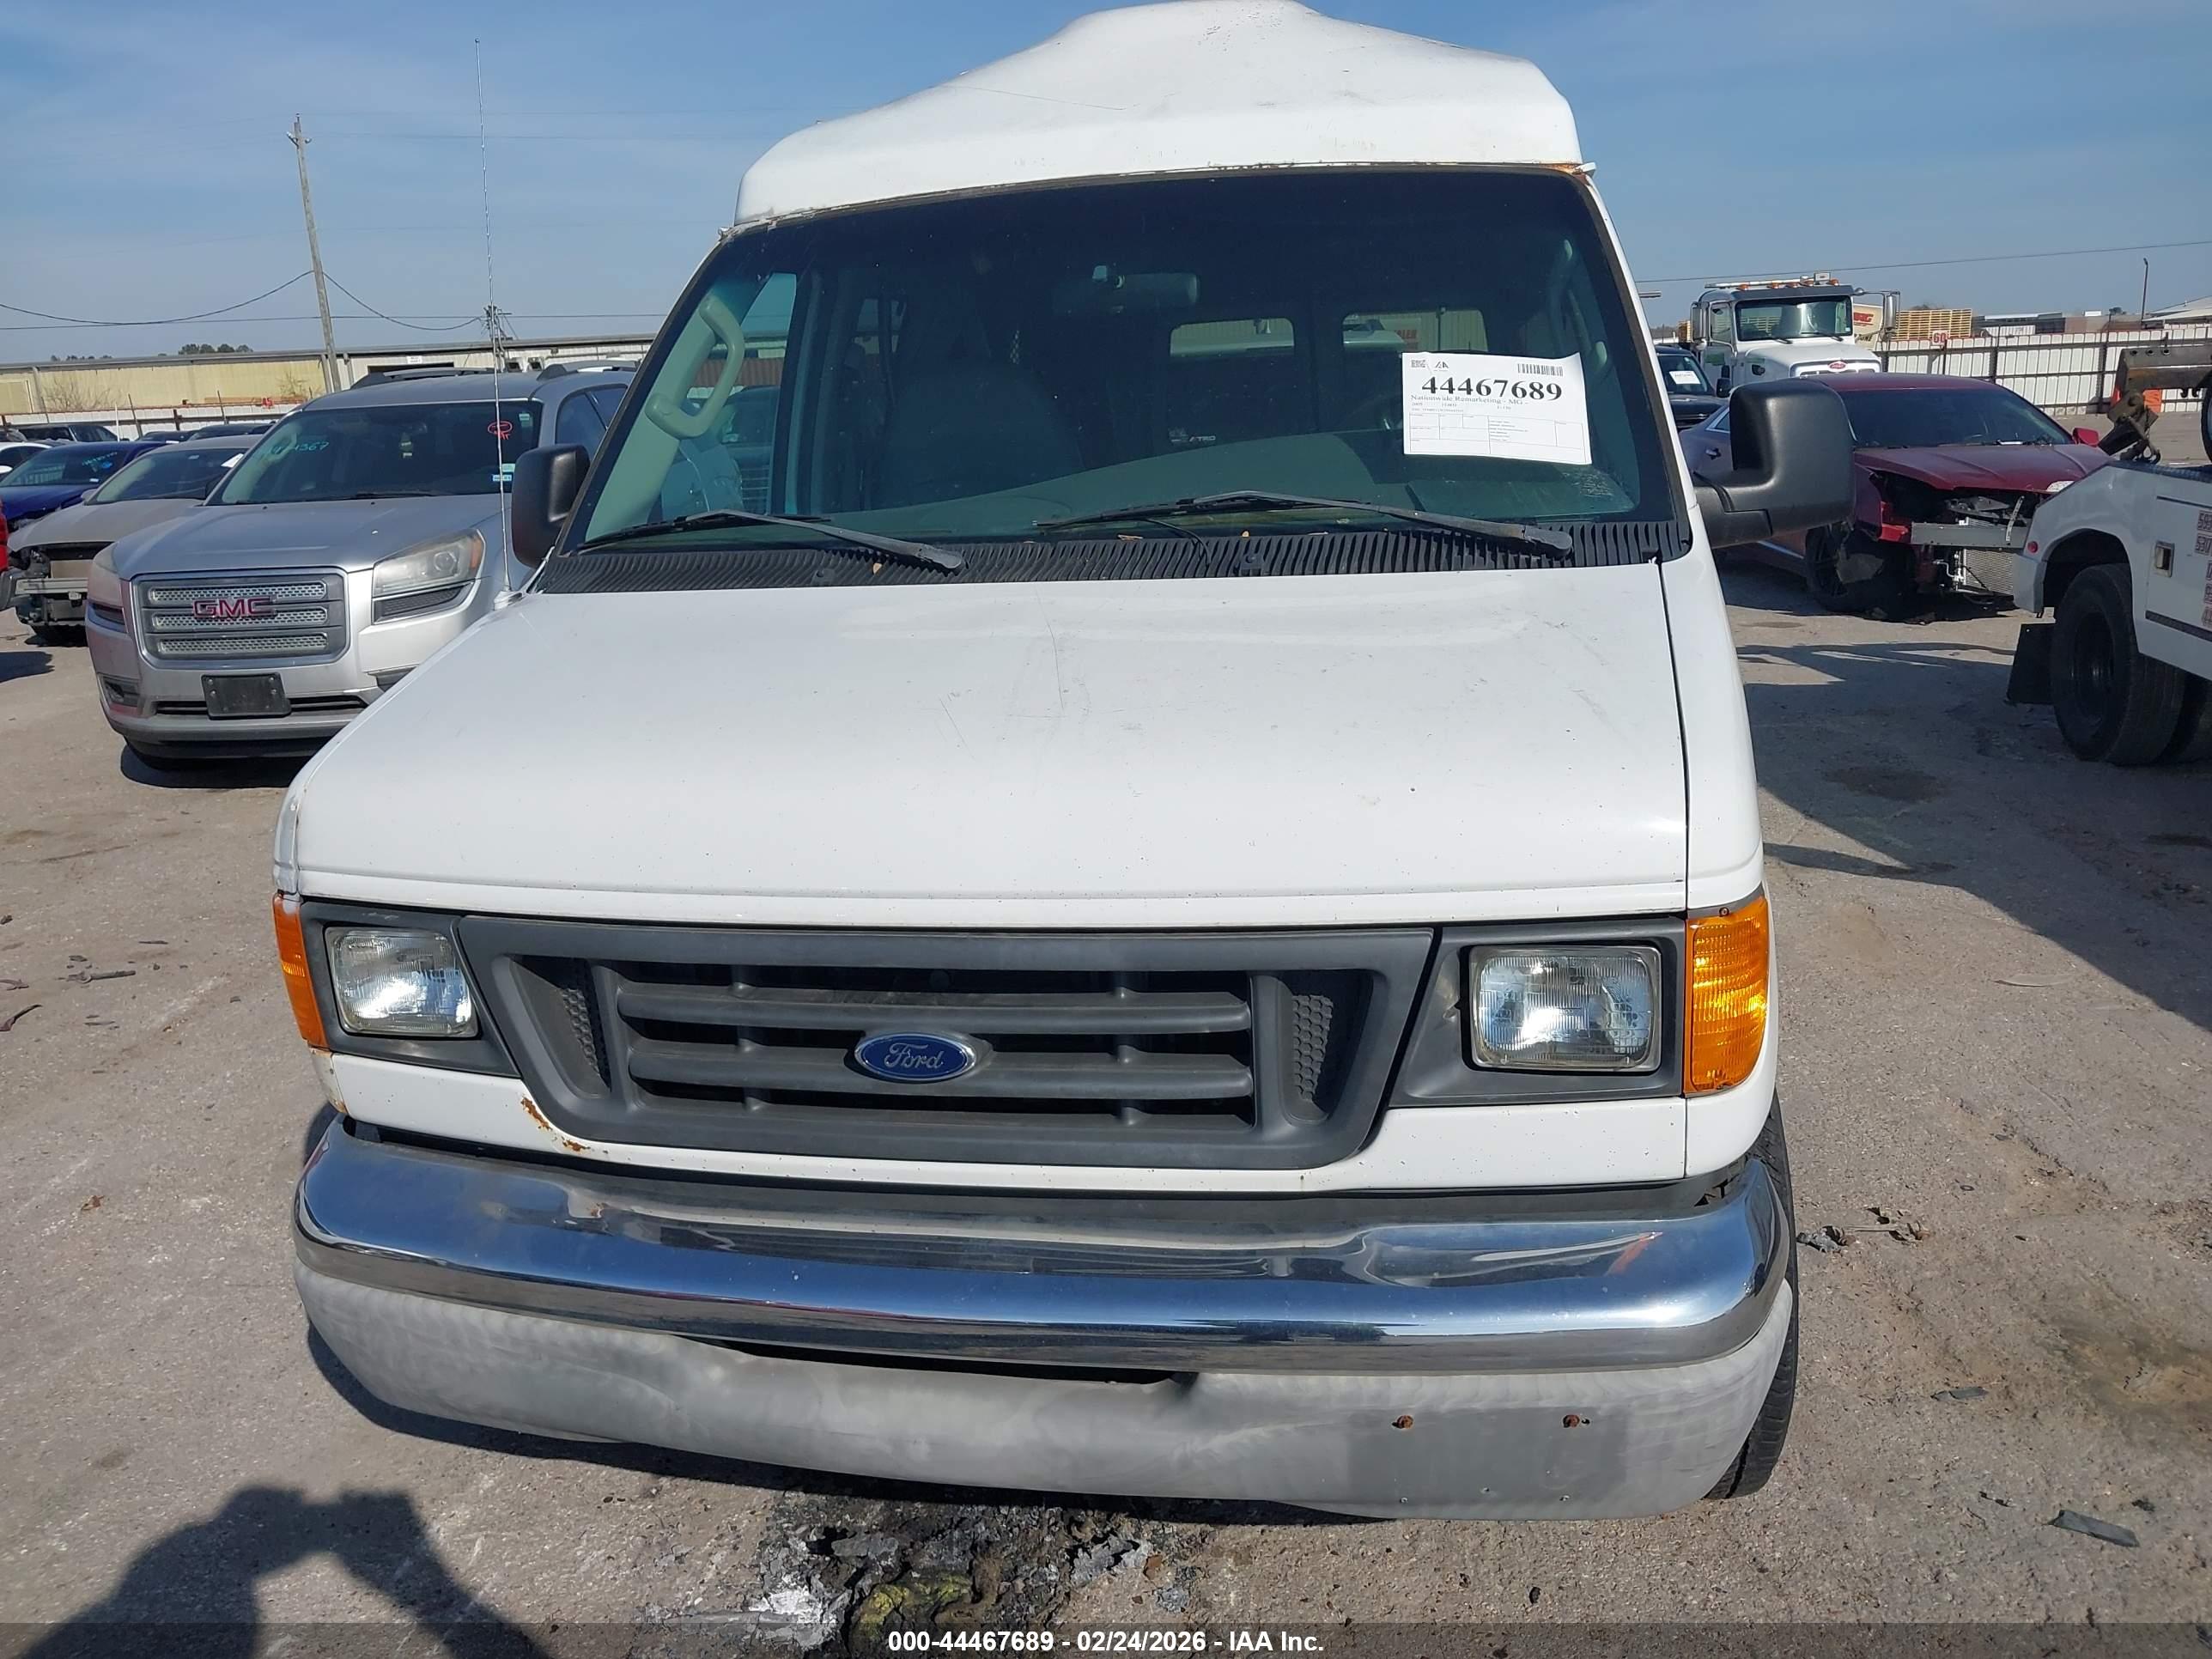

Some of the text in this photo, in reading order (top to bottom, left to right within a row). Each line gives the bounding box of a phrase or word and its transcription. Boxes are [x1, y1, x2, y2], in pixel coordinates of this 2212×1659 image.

[1934, 332, 1946, 343] 60
[1421, 376, 1562, 401] 44467689
[1455, 396, 1502, 404] Remarketing
[192, 595, 275, 618] GMC
[884, 1042, 945, 1069] Ford
